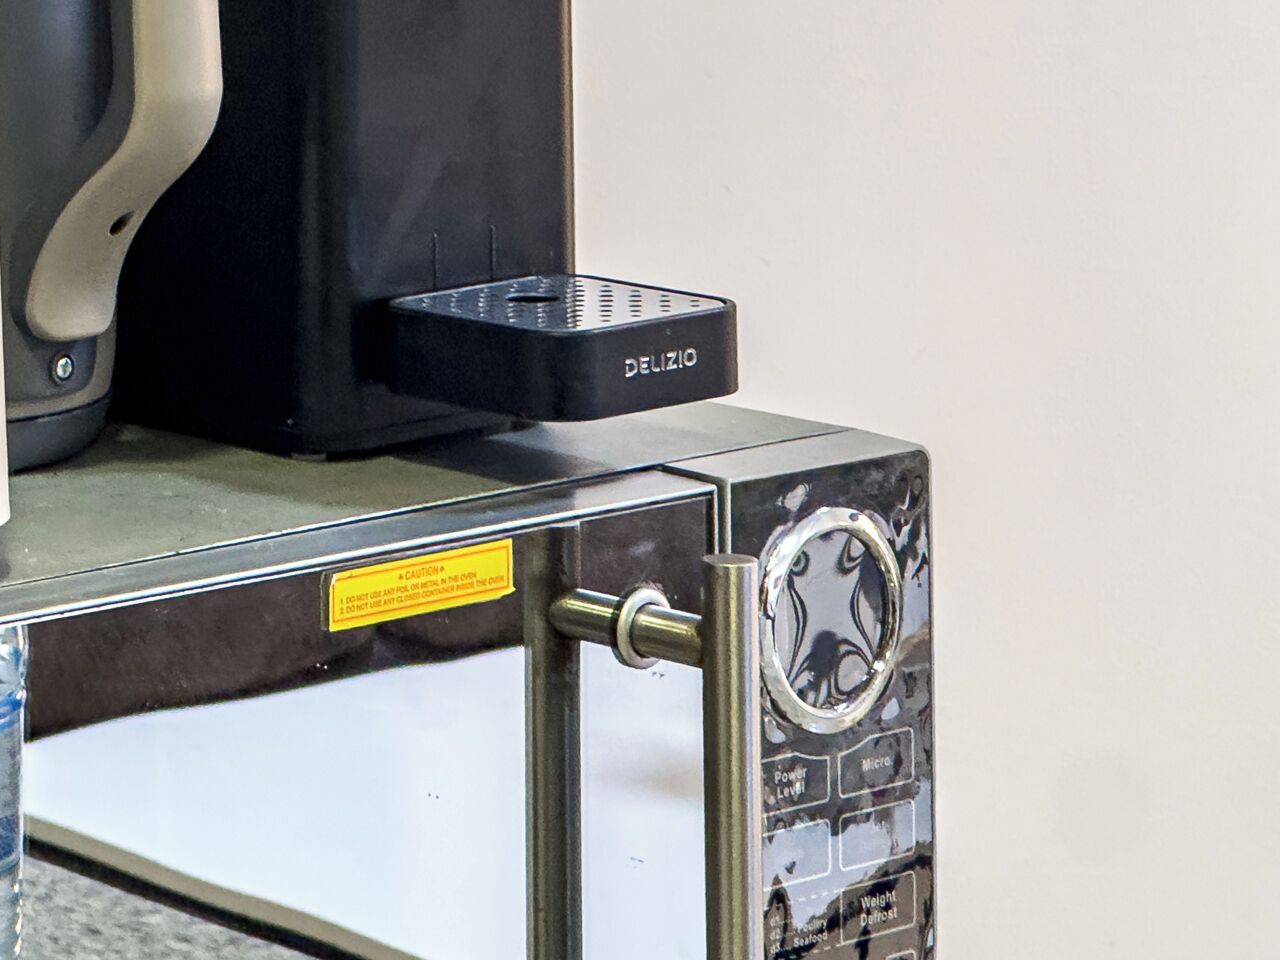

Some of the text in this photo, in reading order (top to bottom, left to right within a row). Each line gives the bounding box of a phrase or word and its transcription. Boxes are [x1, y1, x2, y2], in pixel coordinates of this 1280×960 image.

[624, 347, 697, 378] DELIZIO
[405, 566, 439, 581] CAUTION
[346, 595, 356, 604] DO
[356, 592, 369, 602] NOT
[370, 589, 382, 600] USE
[383, 587, 396, 597] ANY
[411, 582, 420, 591] OR
[448, 574, 460, 583] THE
[346, 604, 356, 614] DO
[356, 601, 369, 611] NOT
[370, 598, 382, 609] USE
[383, 597, 396, 606] ANY
[774, 767, 807, 784] Power
[777, 781, 805, 799] Level
[861, 890, 897, 909] Weight
[860, 906, 897, 927] Defrost
[793, 930, 828, 947] Seafood
